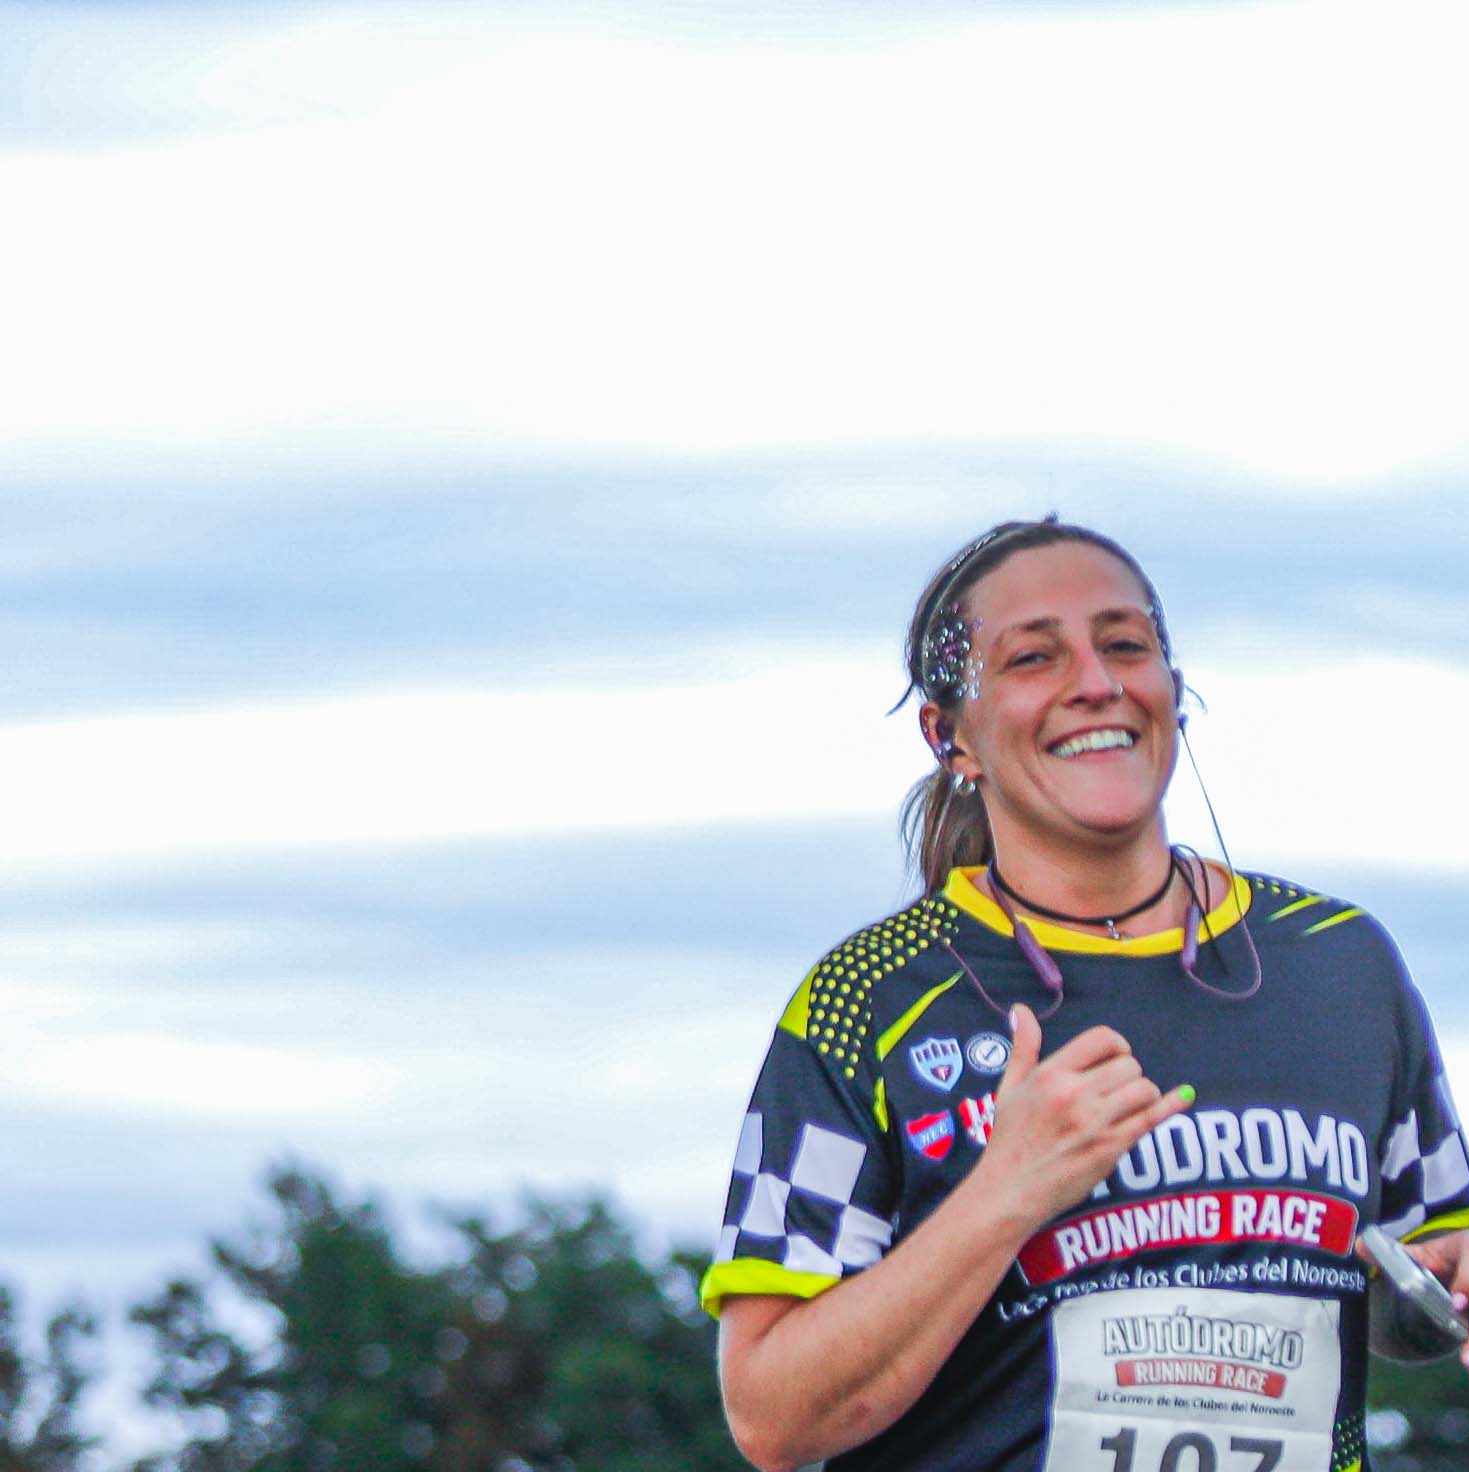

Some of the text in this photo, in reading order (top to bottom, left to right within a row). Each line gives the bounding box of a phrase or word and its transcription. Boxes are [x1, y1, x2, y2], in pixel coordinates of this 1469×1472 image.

[1056, 1194, 1327, 1270] RUNNING RACE
[1134, 1265, 1170, 1288] los
[1174, 1262, 1248, 1287] Clubes
[1252, 1256, 1288, 1281] del
[1102, 1305, 1303, 1370] AUTÓDROMO
[1134, 1361, 1268, 1393] RUNNING RACE
